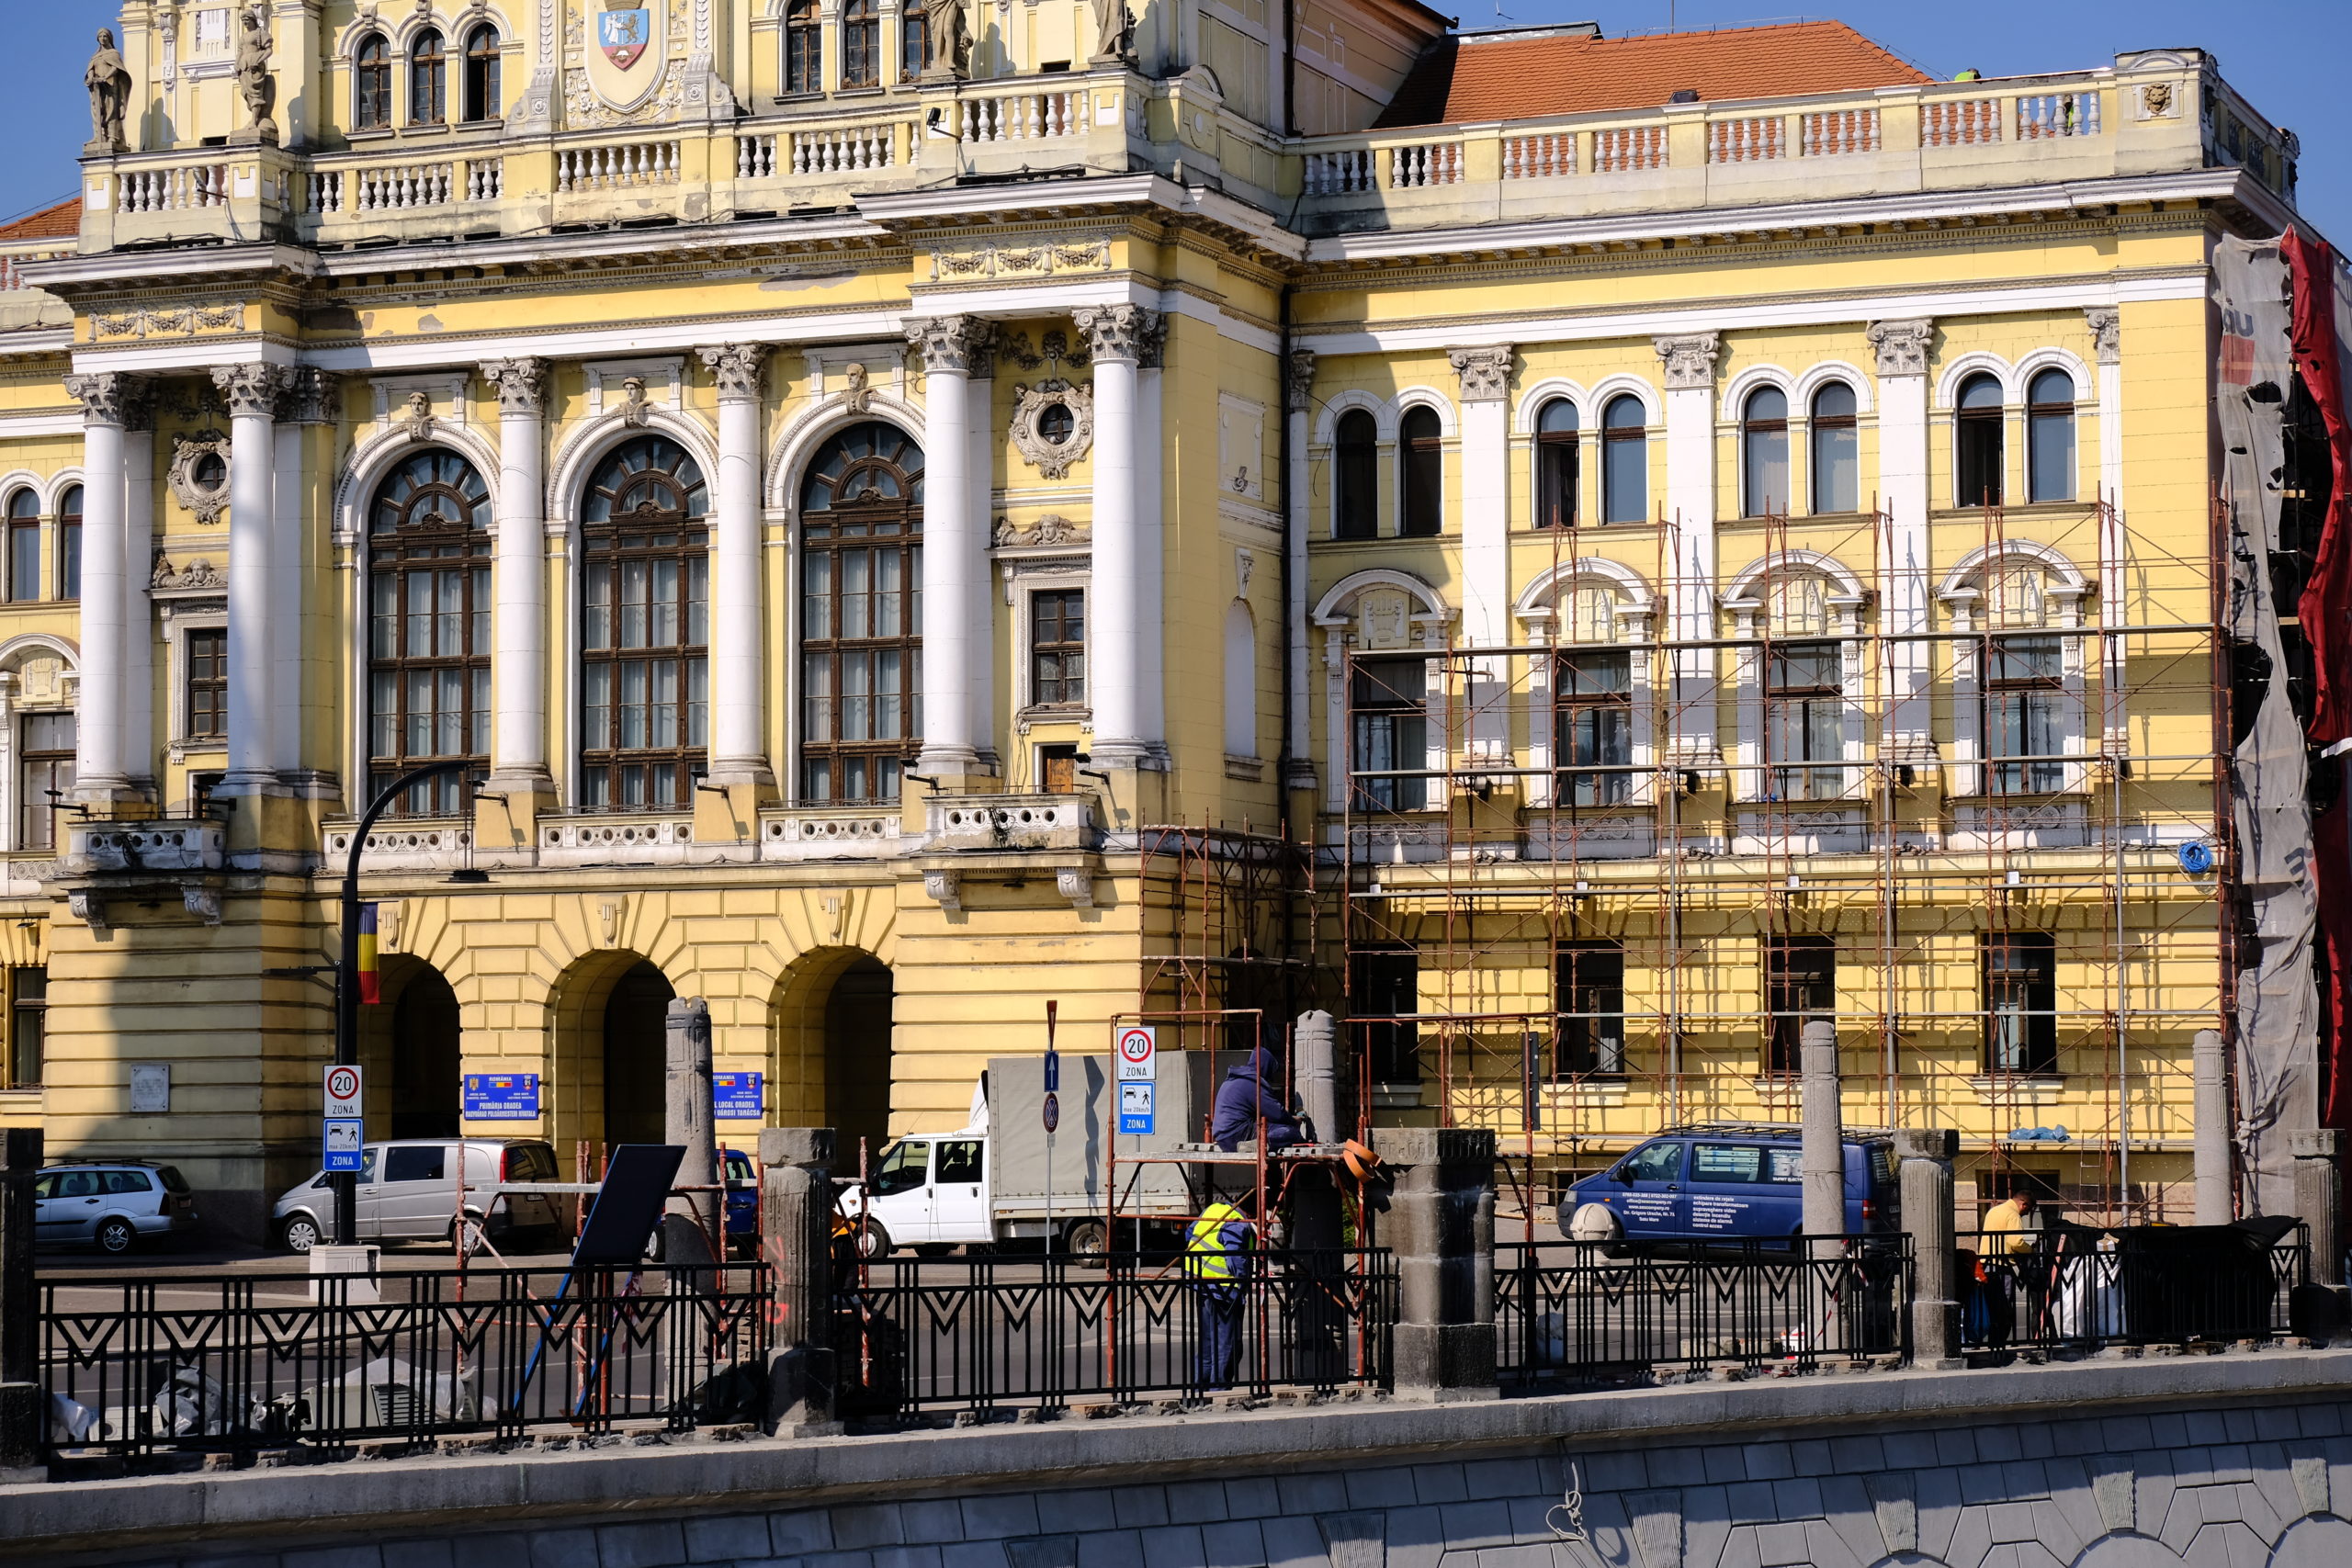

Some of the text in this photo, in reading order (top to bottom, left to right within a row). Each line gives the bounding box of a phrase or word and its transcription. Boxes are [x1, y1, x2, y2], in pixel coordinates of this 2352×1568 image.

[1128, 1038, 1145, 1054] 20
[1125, 1066, 1147, 1077] ZONA
[334, 1076, 352, 1091] 20
[332, 1104, 355, 1114] ZONA
[718, 1100, 734, 1109] LOCAL
[735, 1100, 755, 1109] ORADEA
[1126, 1119, 1147, 1129] ZONA
[332, 1156, 354, 1166] ZONA
